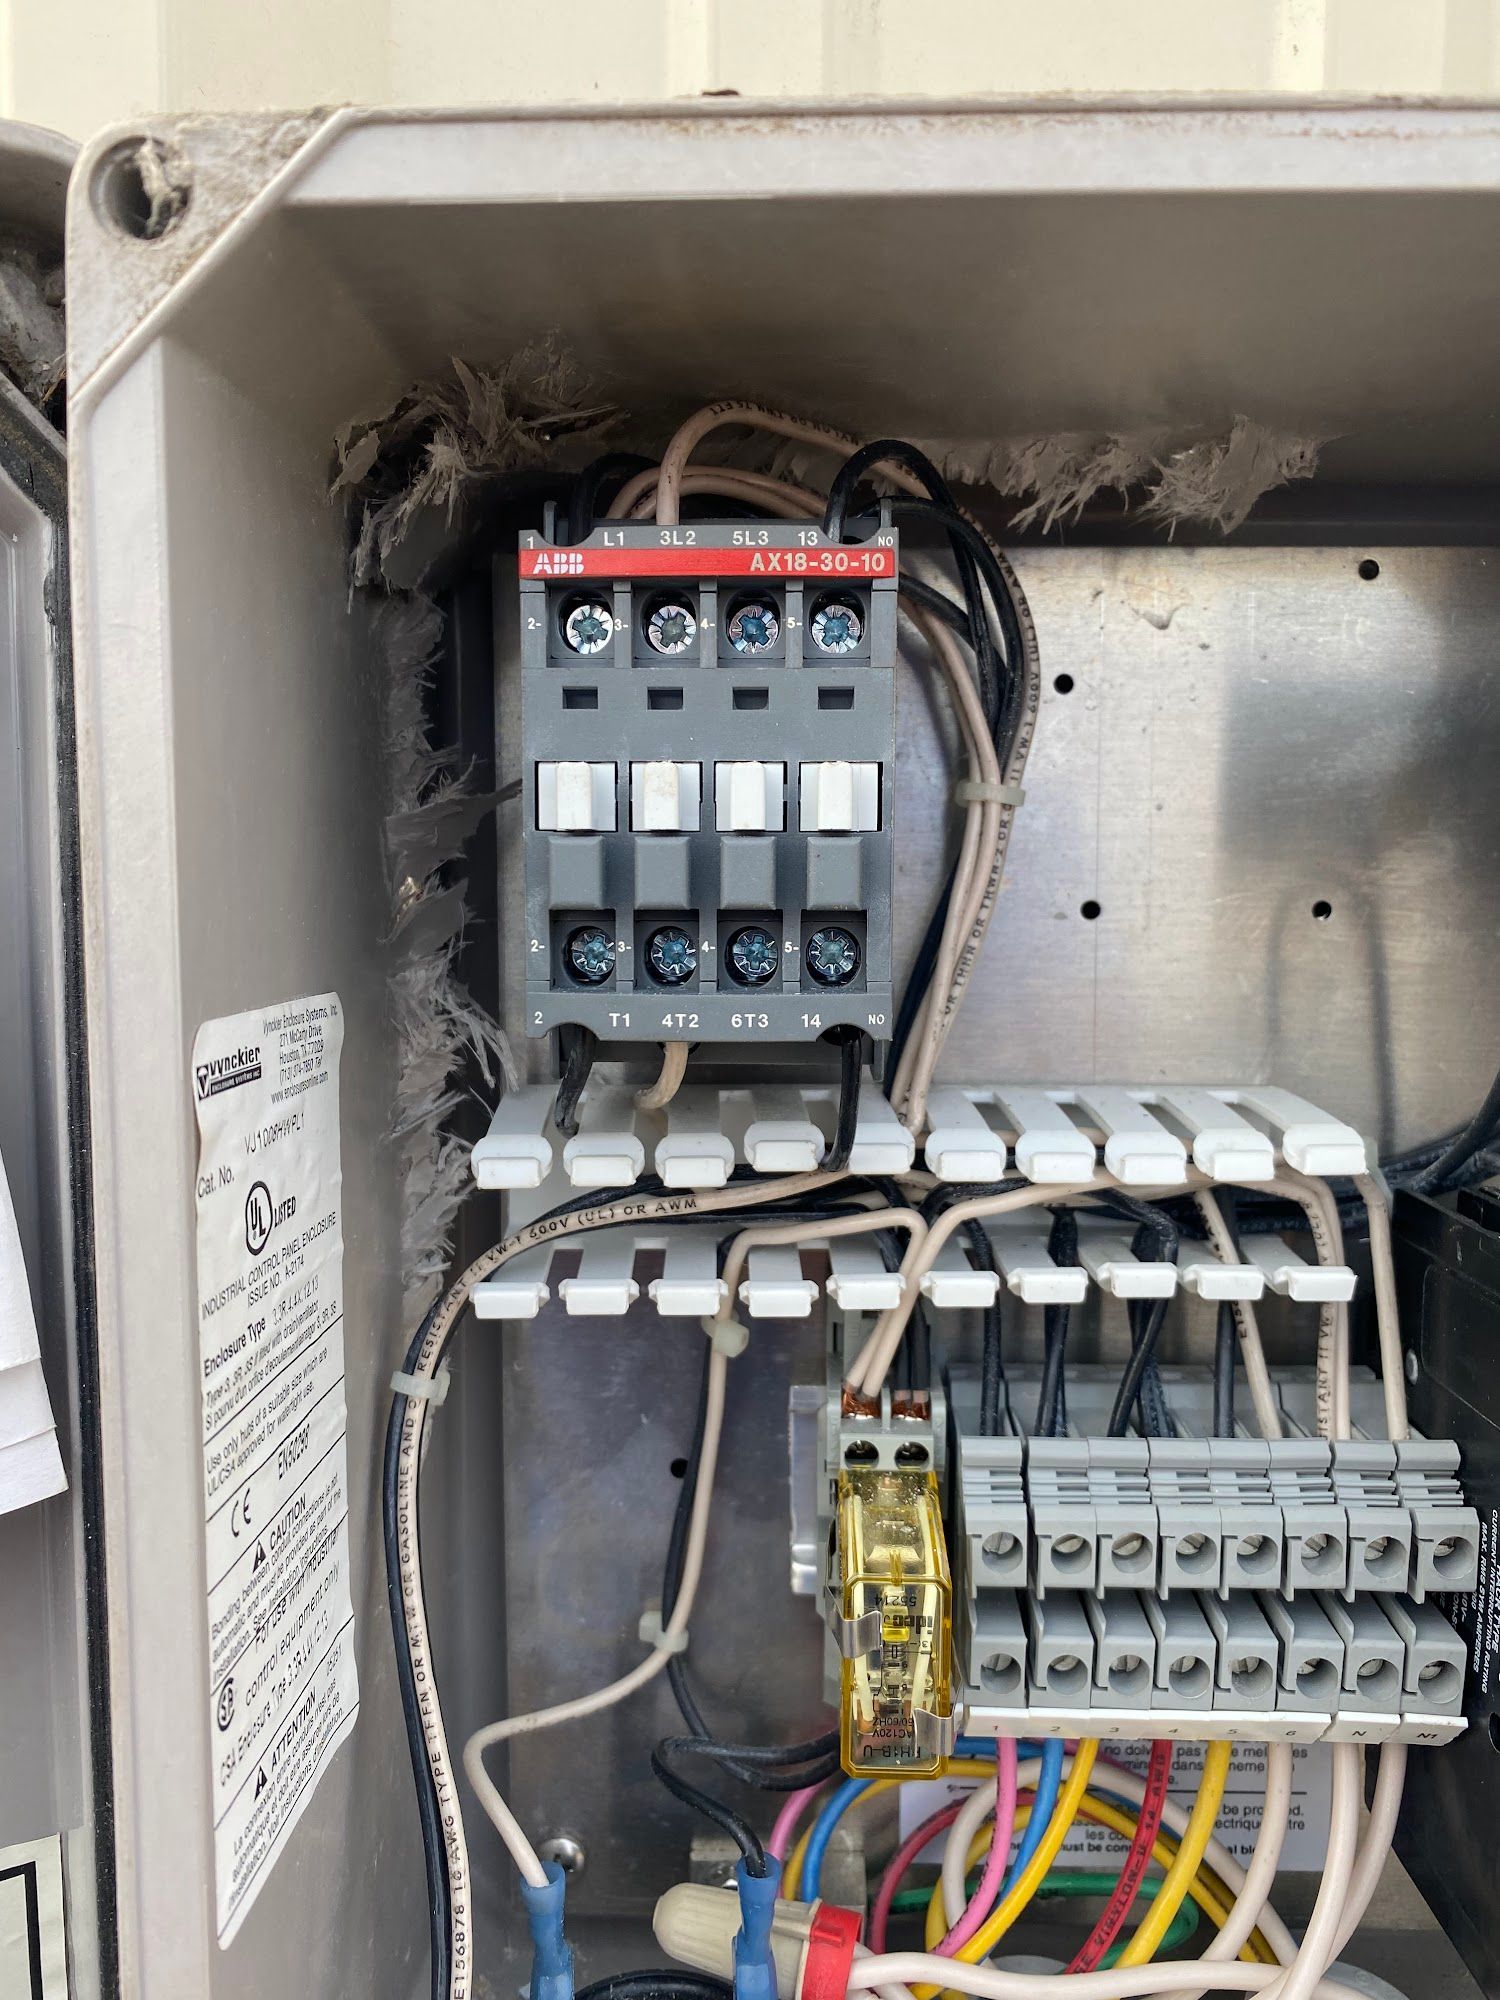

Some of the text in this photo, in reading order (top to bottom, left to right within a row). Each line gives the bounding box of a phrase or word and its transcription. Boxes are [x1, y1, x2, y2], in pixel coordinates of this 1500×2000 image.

[527, 537, 534, 549] 1
[604, 532, 624, 546] L1
[660, 531, 696, 545] 3L2
[733, 531, 768, 545] 5L3
[798, 532, 818, 545] 13
[878, 536, 893, 546] NO
[532, 553, 584, 574] ABB
[750, 553, 885, 572] AX18-30-10
[308, 1023, 322, 1038] Drive
[534, 1012, 543, 1024] 2
[609, 1013, 631, 1027] T1
[662, 1014, 699, 1028] 4T2
[732, 1014, 768, 1027] 6T3
[801, 1014, 821, 1027] 14
[868, 1014, 884, 1025] NO
[209, 1046, 260, 1078] vynckier
[197, 1167, 234, 1199] Cat. No.
[250, 1193, 296, 1237] UL LISTED
[202, 1210, 335, 1320] INDUSTRIAL CONTROL PANEL ENCLOSURE
[247, 1279, 267, 1307] ISSUE
[269, 1271, 281, 1291] NO.
[418, 1199, 697, 1373] RESISTANT VW-1 600V (UL) OR AWM
[204, 1316, 265, 1378] Enclosure Type
[206, 1451, 221, 1476] Use
[223, 1435, 238, 1459] only
[239, 1418, 253, 1443] hubs
[254, 1408, 261, 1428] of
[262, 1407, 266, 1420] a
[268, 1383, 290, 1415] suitable
[291, 1372, 301, 1391] size
[319, 1347, 327, 1364] are
[237, 1425, 265, 1468] approved
[266, 1418, 275, 1437] for
[402, 1417, 414, 1456] AND
[270, 1492, 306, 1551] CAUTION
[400, 1467, 410, 1564] GASOLINE
[211, 1595, 240, 1641] Bonding
[242, 1558, 270, 1602] between
[271, 1529, 290, 1565] conduit
[212, 1486, 341, 1663] automatic and must be provided as part of the
[1473, 1521, 1488, 1673] MAX. RMS SYM AMPERES
[1481, 1509, 1498, 1694] CURRENT INTERRUPTING RATING
[253, 1603, 266, 1631] See
[255, 1620, 269, 1652] For
[272, 1597, 286, 1628] use
[245, 1559, 340, 1708] control equipment only
[415, 1657, 425, 1682] OR
[271, 1685, 315, 1773] ATTENTION
[1177, 1746, 1200, 1757] pas
[433, 1752, 450, 1803] TYPE
[1223, 1804, 1239, 1815] be
[454, 1904, 465, 2000] E156878
